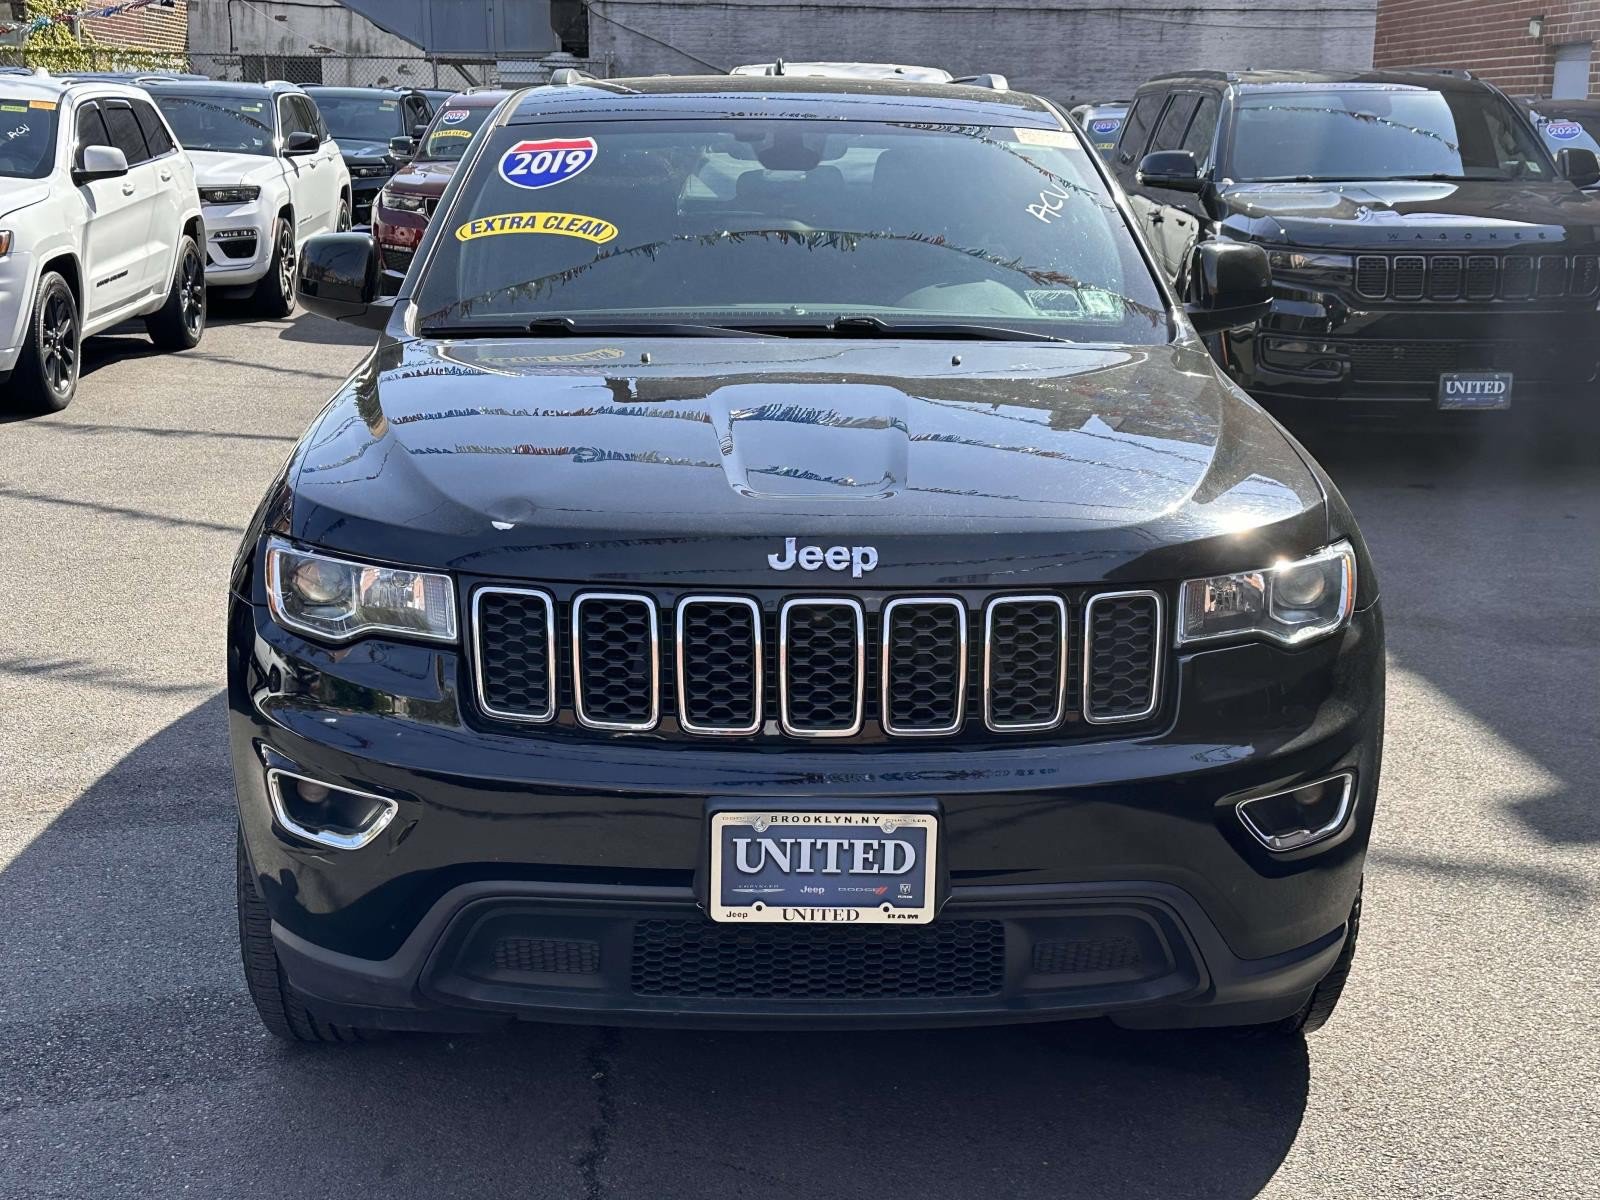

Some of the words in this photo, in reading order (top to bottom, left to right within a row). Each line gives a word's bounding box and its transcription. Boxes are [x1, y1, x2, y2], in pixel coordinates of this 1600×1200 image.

[1550, 127, 1580, 135] 2023
[508, 150, 587, 176] 2019
[470, 215, 537, 235] EXTRA
[543, 215, 609, 237] CLEAN
[1446, 381, 1506, 394] UNITED
[767, 537, 879, 578] Jeep
[732, 838, 916, 875] UNITED
[800, 885, 825, 895] Jeep
[726, 910, 749, 919] Jeep
[782, 908, 860, 922] UNITED
